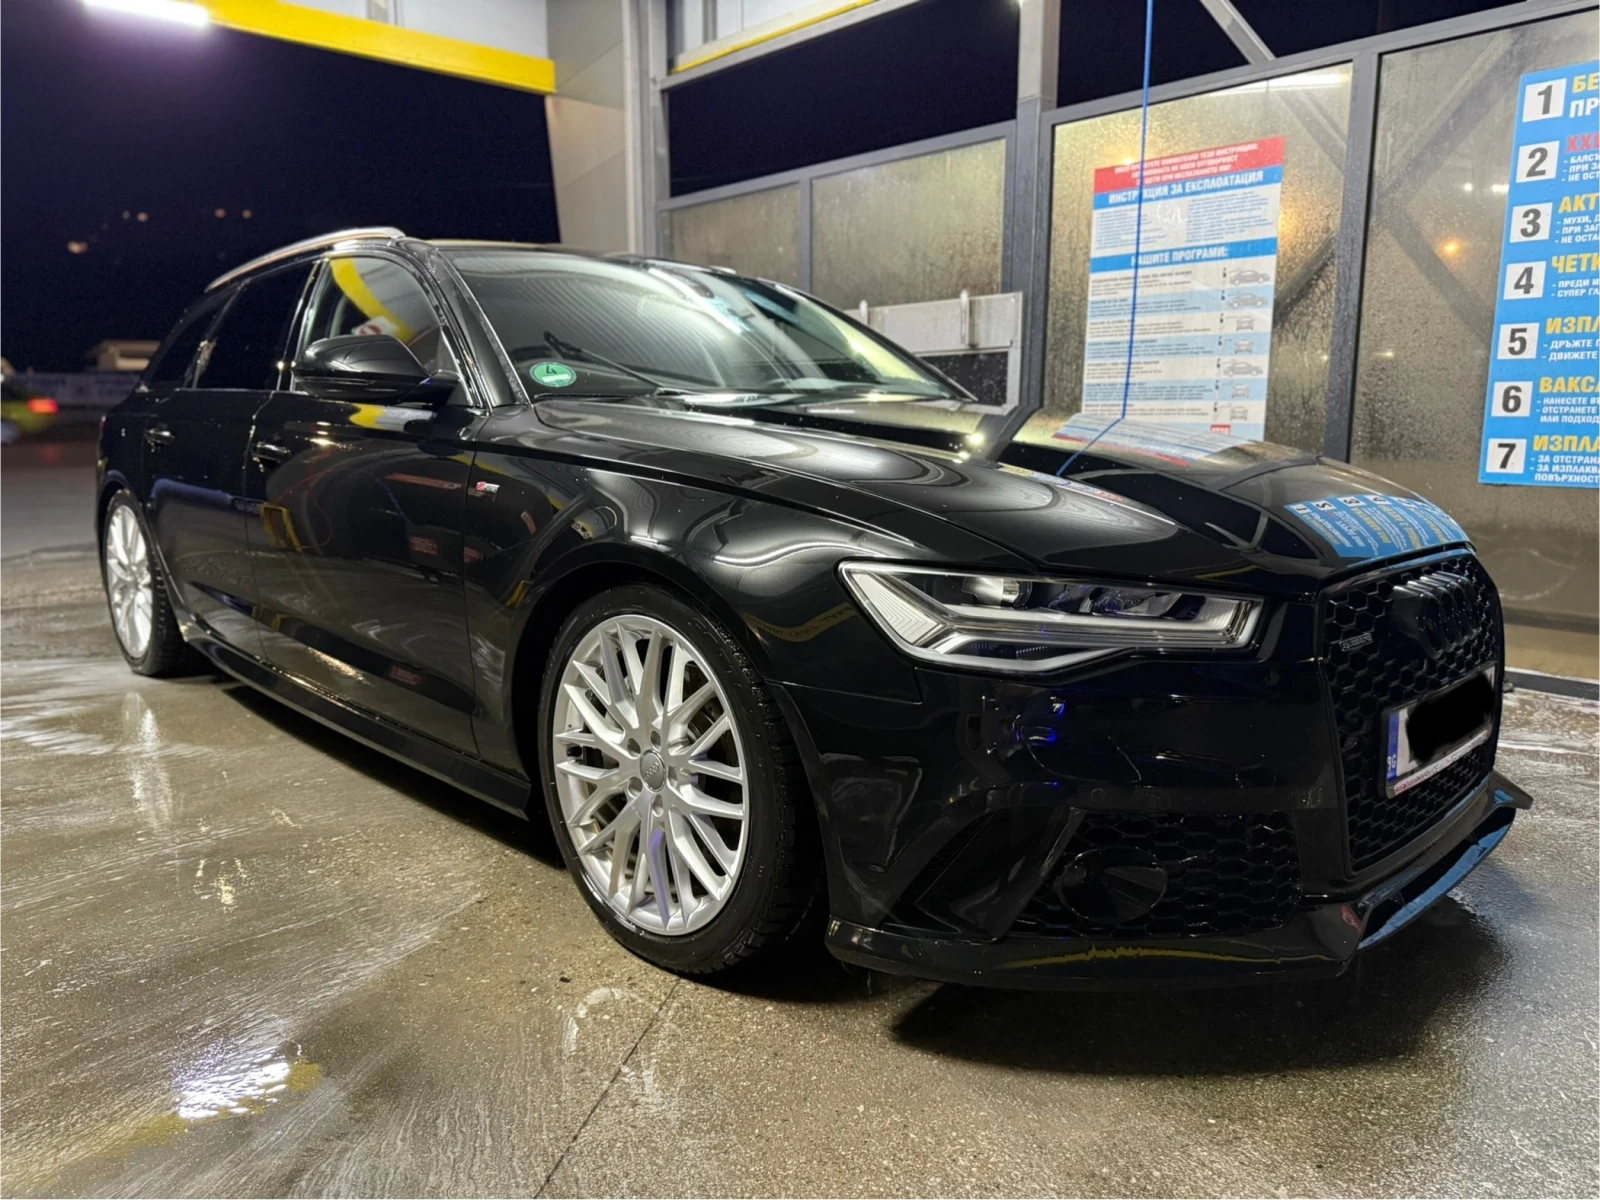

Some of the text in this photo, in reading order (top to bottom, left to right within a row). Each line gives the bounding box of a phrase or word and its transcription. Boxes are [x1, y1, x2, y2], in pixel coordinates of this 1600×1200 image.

[1537, 85, 1553, 115] 1
[1526, 147, 1548, 178] 2
[1569, 163, 1589, 173] ПРИ
[1568, 173, 1581, 182] НЕ
[1108, 185, 1169, 204] ИНСТРКЦИЯ
[1170, 183, 1183, 195] ЗА
[1185, 170, 1264, 193] ЕКСПЛОАТАЦИЯ
[1520, 208, 1541, 237] 3
[1562, 225, 1581, 234] ПРИ
[1561, 235, 1573, 244] НЕ
[1513, 266, 1534, 294] 4
[1558, 279, 1590, 288] ПРЕДИ
[1557, 288, 1587, 297] СУПЕР
[1508, 328, 1527, 356] 5
[1550, 339, 1593, 349] ДРЪЖТЕ
[1548, 351, 1598, 362] ДВИЖЕТЕ
[1502, 385, 1522, 413] 6
[1543, 397, 1588, 405] НАНЕСЕТЕ
[1542, 406, 1598, 414] ОТСТРАНЕТЕ
[1540, 415, 1560, 423] ИЛИ
[1497, 443, 1516, 469] 7
[1537, 454, 1550, 463] ЗА
[1536, 463, 1549, 472] ЗА
